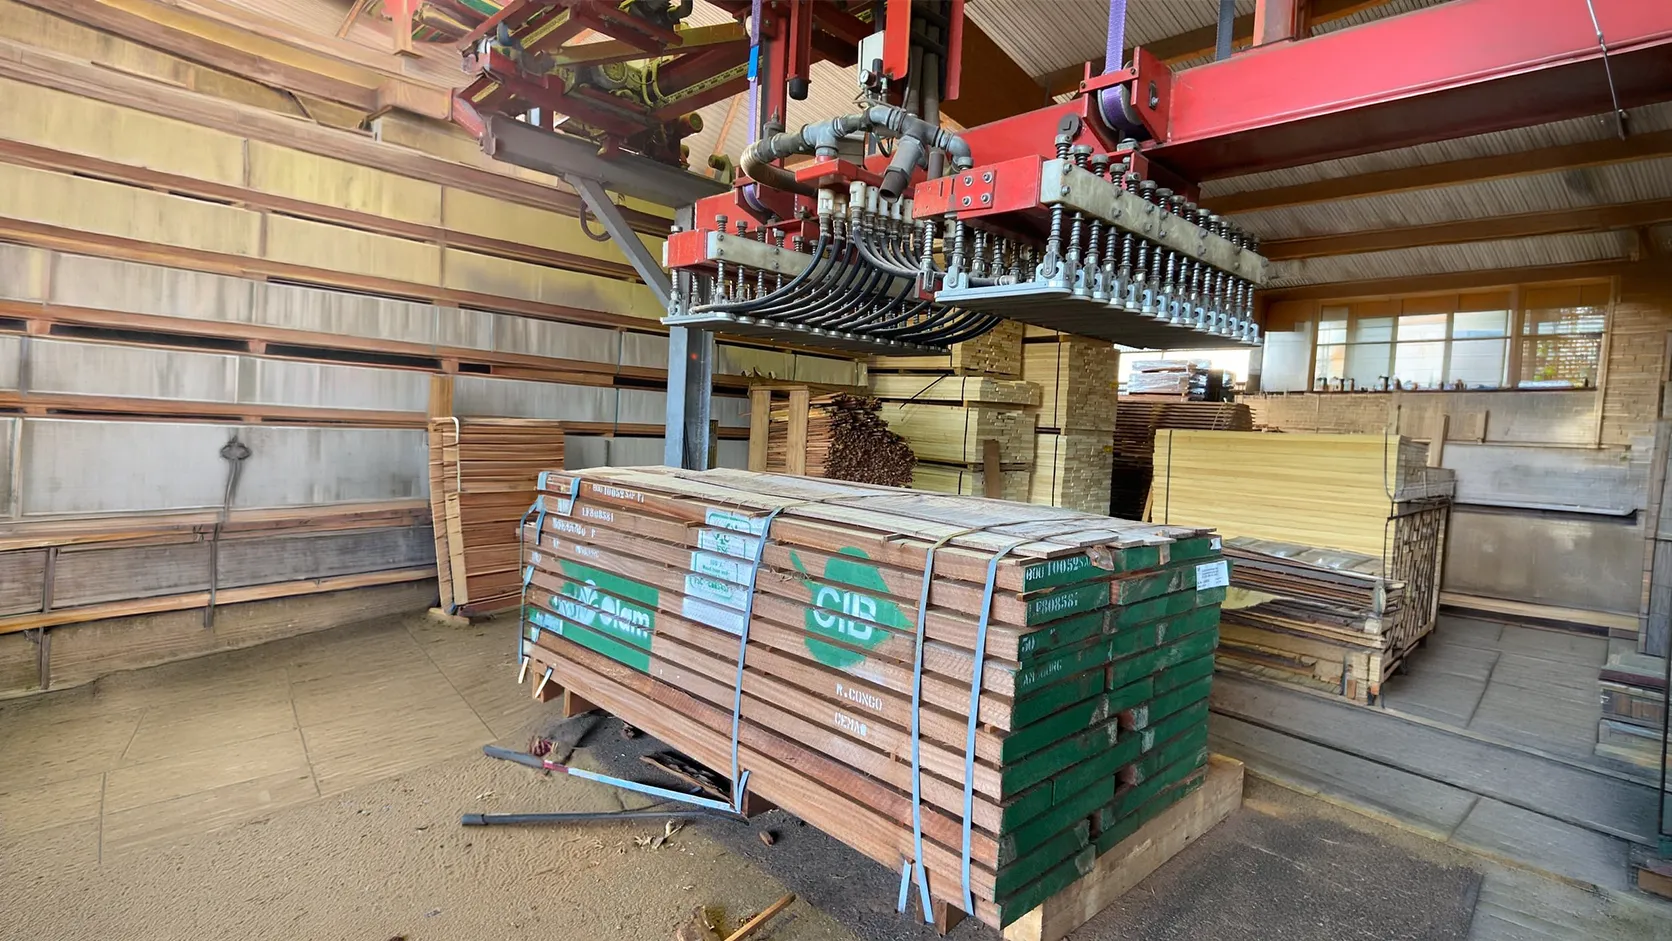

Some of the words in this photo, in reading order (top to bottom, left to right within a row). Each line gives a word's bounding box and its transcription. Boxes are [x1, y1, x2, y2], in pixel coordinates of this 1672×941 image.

[599, 595, 650, 639] Olam
[813, 586, 877, 640] CIB
[836, 683, 883, 712] R.CONGO
